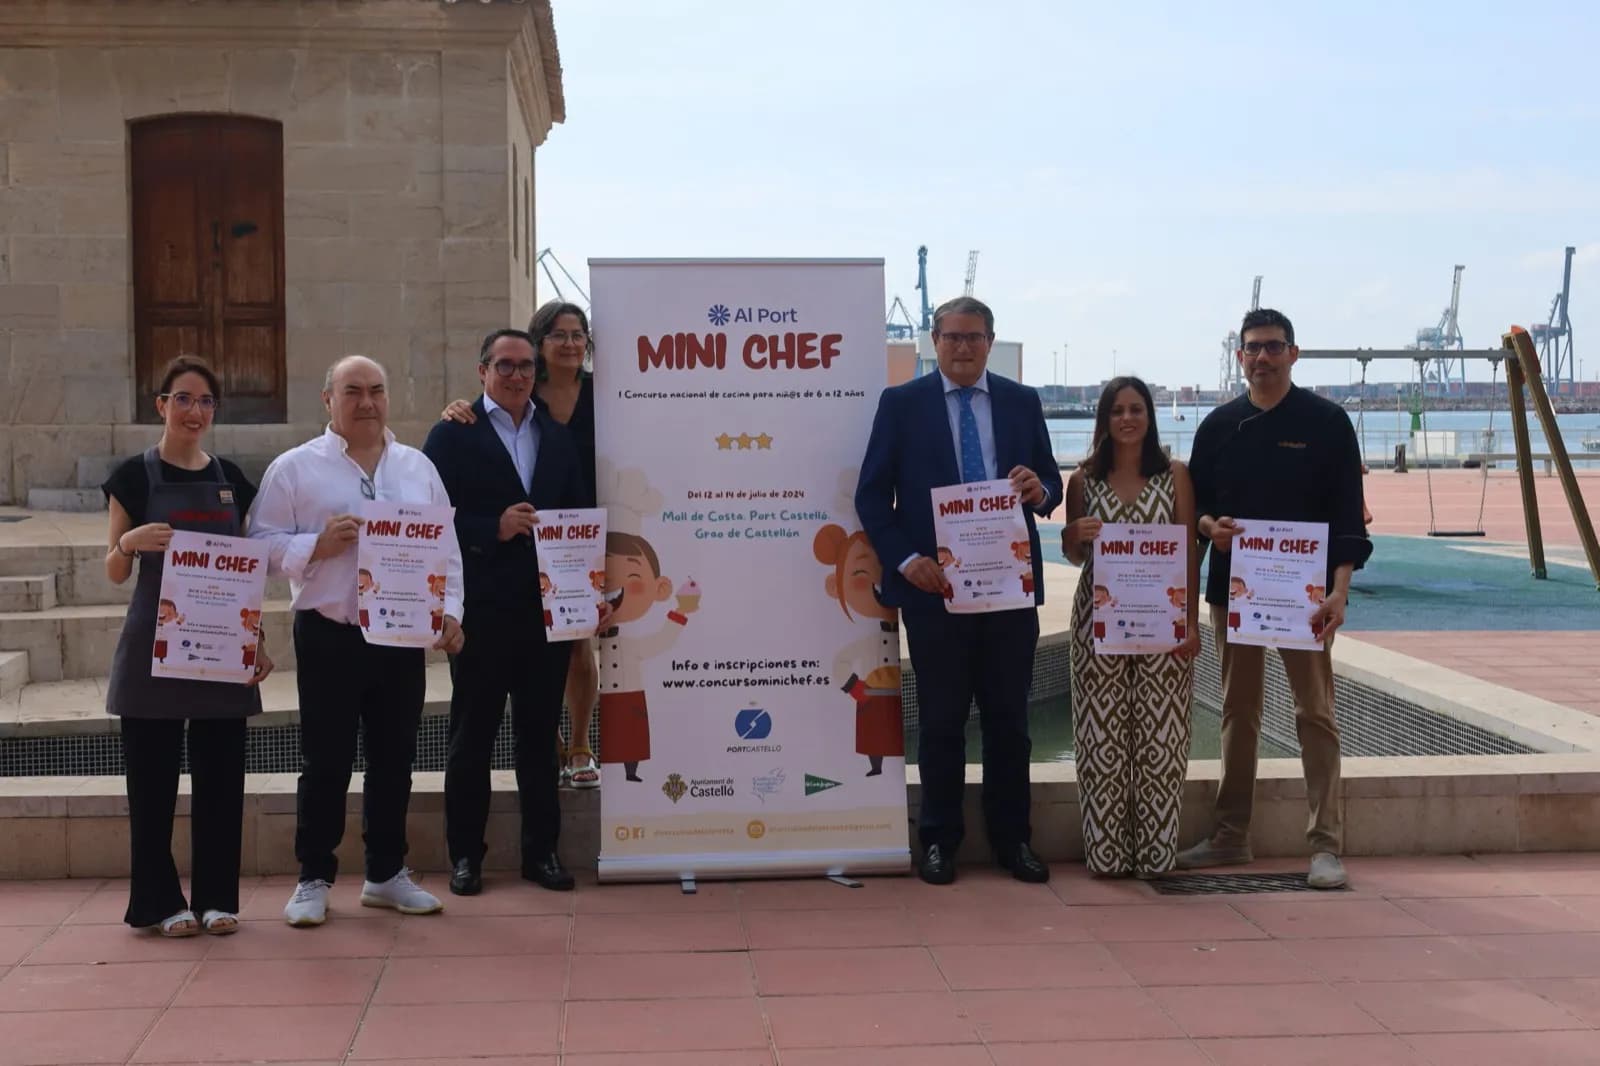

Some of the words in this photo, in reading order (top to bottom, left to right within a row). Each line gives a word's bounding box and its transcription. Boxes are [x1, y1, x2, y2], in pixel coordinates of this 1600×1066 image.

[733, 307, 752, 323] Al
[757, 308, 798, 323] Port
[637, 332, 727, 373] MINI
[742, 332, 843, 370] CHEF
[624, 390, 668, 399] Concurso
[670, 391, 707, 399] nacional
[709, 390, 720, 398] de
[722, 391, 750, 399] cocina
[752, 391, 774, 400] para
[776, 391, 801, 399] niñ@s
[803, 390, 814, 398] de
[816, 389, 823, 398] 6
[833, 389, 842, 398] 12
[844, 389, 865, 398] años
[687, 490, 701, 499] Del
[704, 490, 713, 499] 12
[715, 490, 723, 498] al
[725, 490, 735, 498] 14
[736, 490, 747, 498] de
[749, 489, 767, 500] julio
[769, 489, 780, 498] de
[782, 489, 805, 498] 2024
[939, 498, 974, 517] MINI
[979, 495, 1017, 513] CHEF
[662, 510, 688, 522] Moll
[690, 510, 704, 522] de
[749, 509, 776, 521] Port
[367, 520, 402, 537] MINI
[405, 522, 445, 540] CHEF
[537, 524, 563, 542] MINI
[567, 524, 601, 540] CHEF
[694, 528, 724, 539] Grao
[727, 527, 741, 538] de
[744, 527, 800, 538] Castellón
[1101, 540, 1135, 556] MINI
[1139, 540, 1179, 556] CHEF
[1239, 537, 1274, 552] MINI
[1279, 538, 1320, 555] CHEF
[171, 550, 210, 569] MINI
[215, 554, 260, 574] CHEF
[671, 659, 699, 672] Info
[702, 661, 710, 670] e
[714, 658, 797, 673] inscripciones
[801, 659, 820, 669] en:
[662, 674, 830, 689] www.concursominichef.es
[690, 777, 725, 786] Ajuntament
[726, 777, 735, 785] de
[690, 784, 735, 798] Castelló
